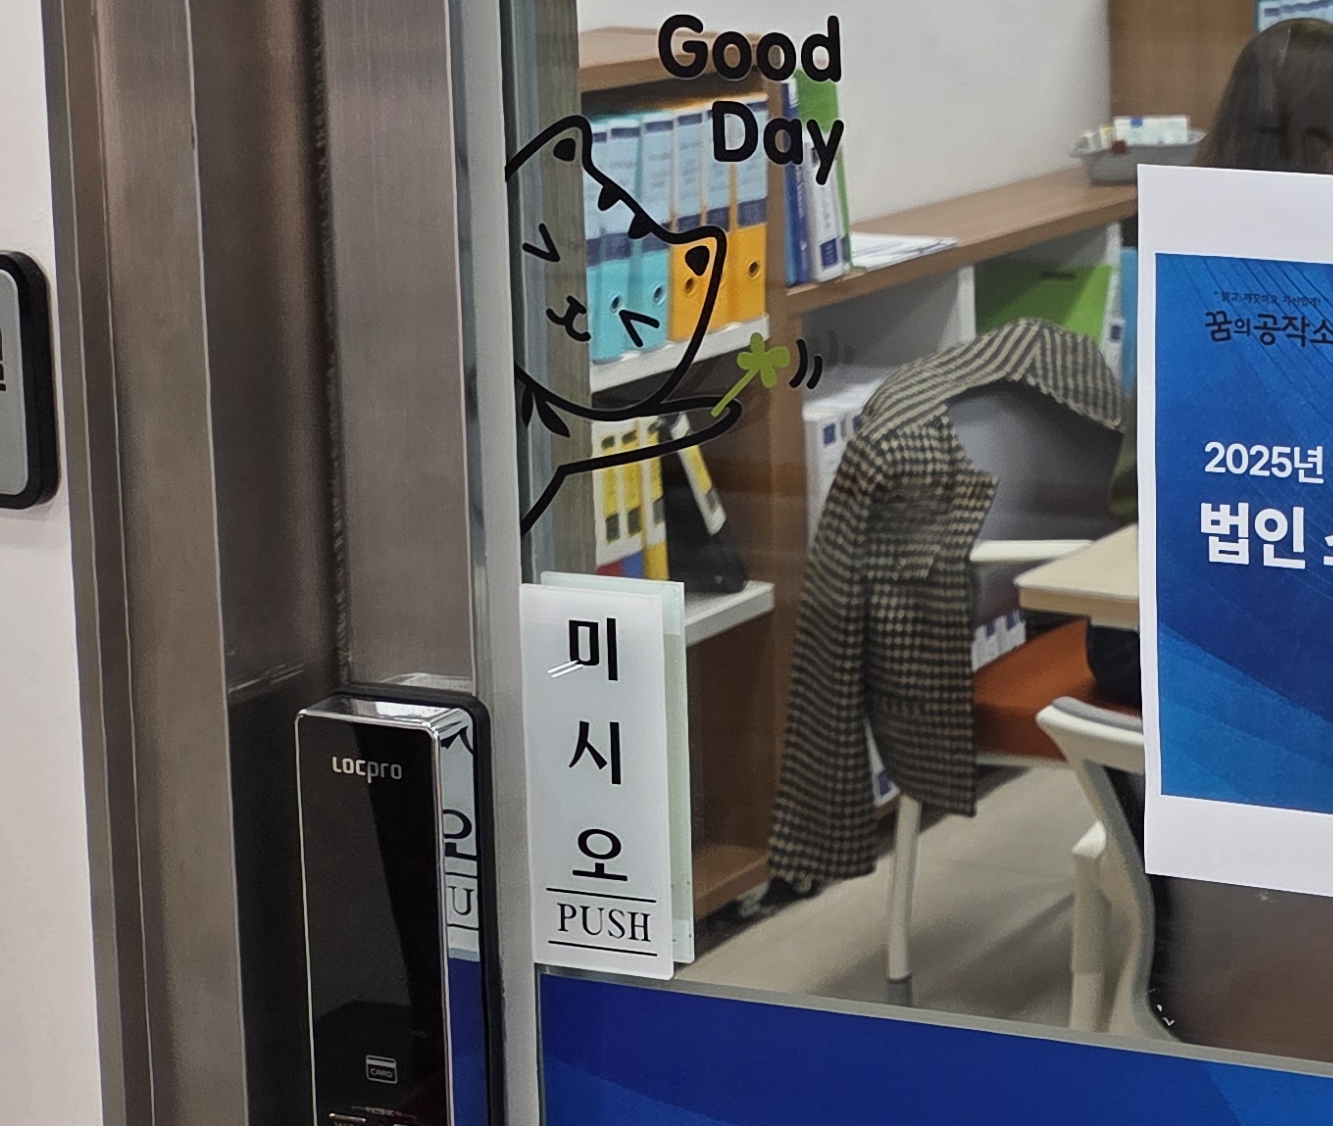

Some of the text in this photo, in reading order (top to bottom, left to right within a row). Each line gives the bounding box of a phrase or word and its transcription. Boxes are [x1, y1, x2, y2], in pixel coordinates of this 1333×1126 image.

[658, 14, 842, 82] Good
[712, 100, 844, 186] Day
[1204, 441, 1324, 485] 2025년
[1200, 502, 1307, 571] 법인
[557, 901, 653, 944] PUSH
